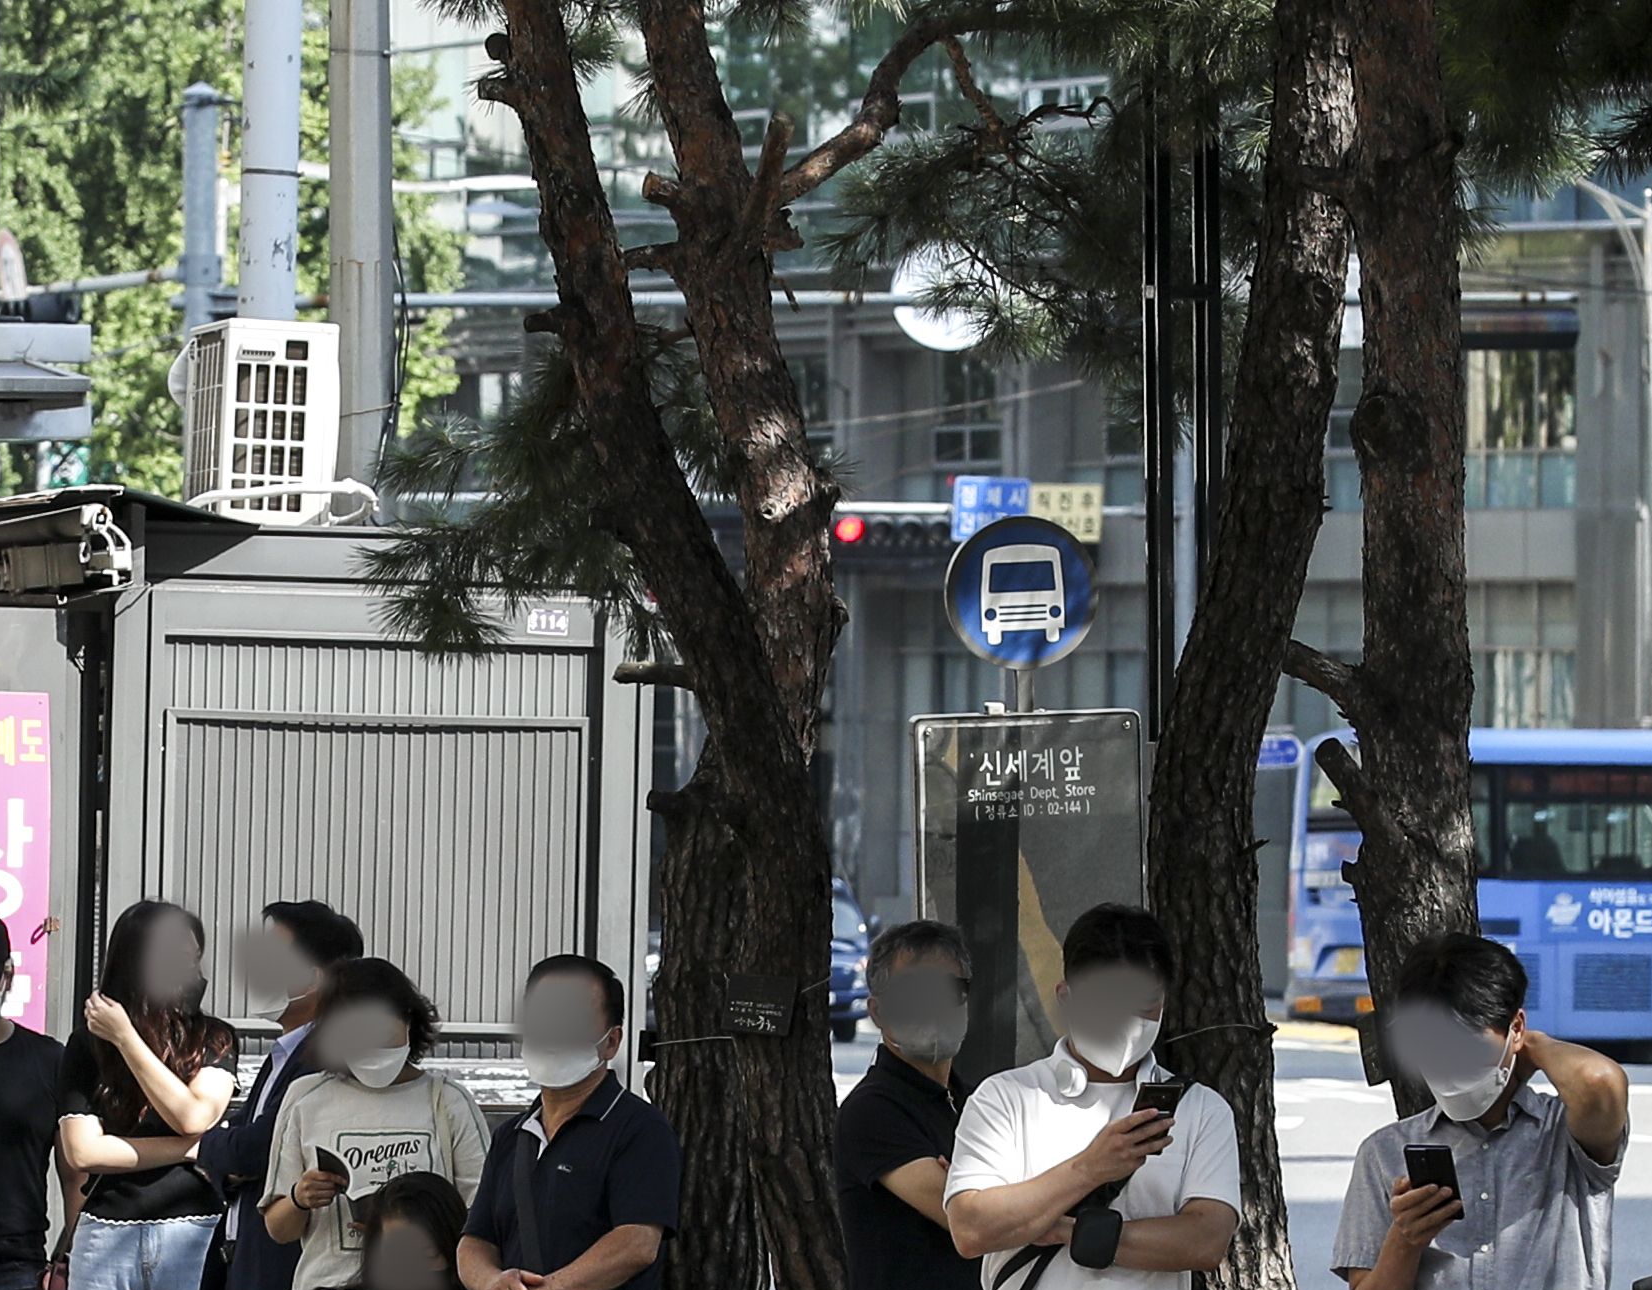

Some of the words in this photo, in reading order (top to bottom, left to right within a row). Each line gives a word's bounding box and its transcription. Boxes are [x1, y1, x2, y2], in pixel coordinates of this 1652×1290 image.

[979, 746, 1084, 787] 신세계앞
[967, 789, 1025, 804] Shinsegae
[1030, 786, 1060, 801] Dept.
[1065, 783, 1096, 798] Store
[985, 805, 1019, 821] 정류소
[1024, 804, 1035, 817] ID
[1047, 801, 1082, 816] 02-144
[344, 1138, 421, 1170] Dreams
